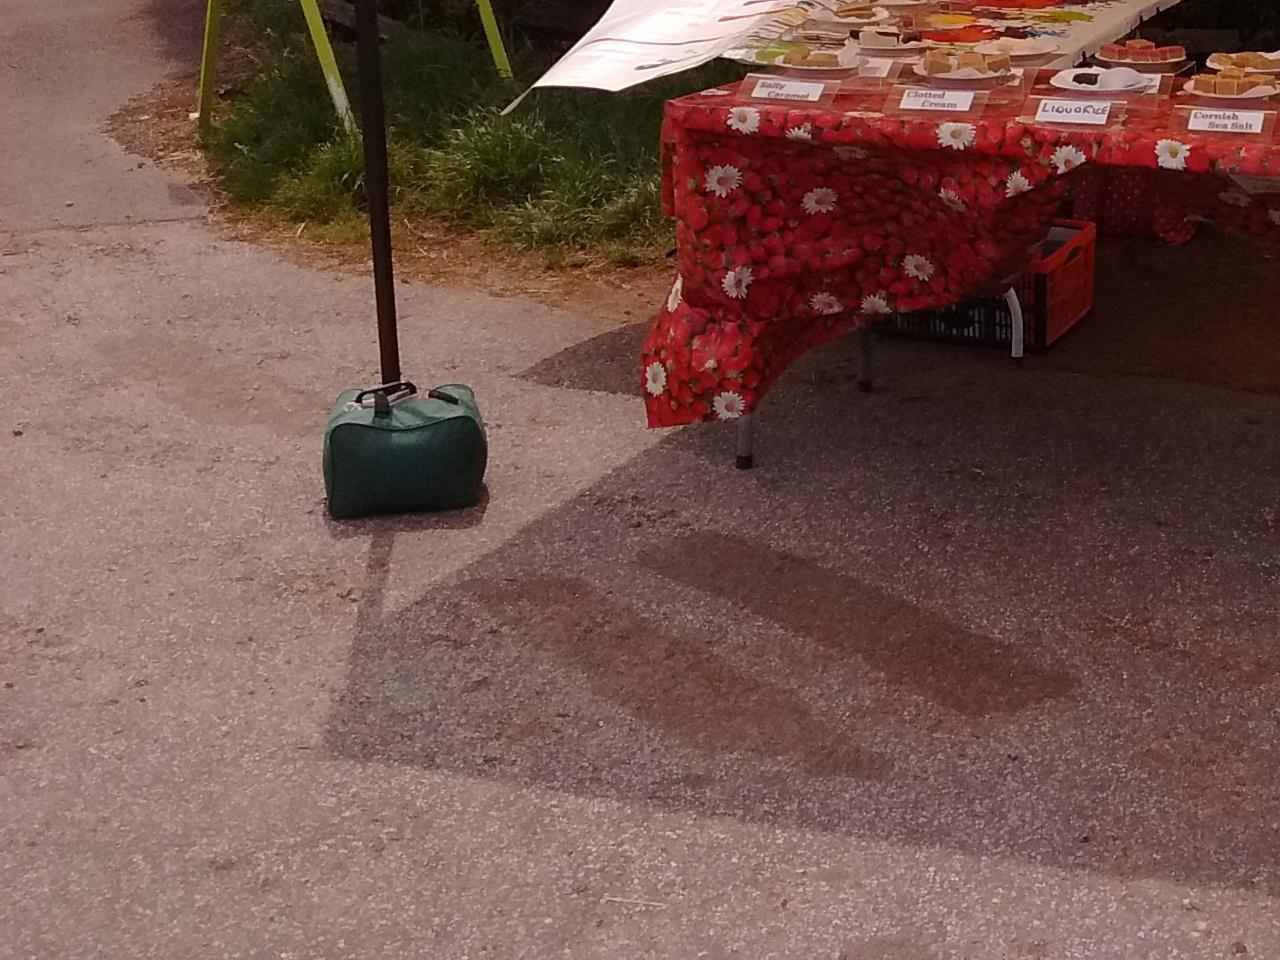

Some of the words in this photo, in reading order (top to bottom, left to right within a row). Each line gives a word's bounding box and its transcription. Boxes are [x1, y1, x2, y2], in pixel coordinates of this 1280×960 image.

[760, 80, 786, 90] Salty
[767, 90, 810, 99] Caramel
[906, 91, 946, 99] Clotted
[921, 100, 957, 108] Cream
[1193, 111, 1239, 120] Cornish
[1207, 121, 1228, 129] Sea
[1230, 121, 1253, 130] Salt
